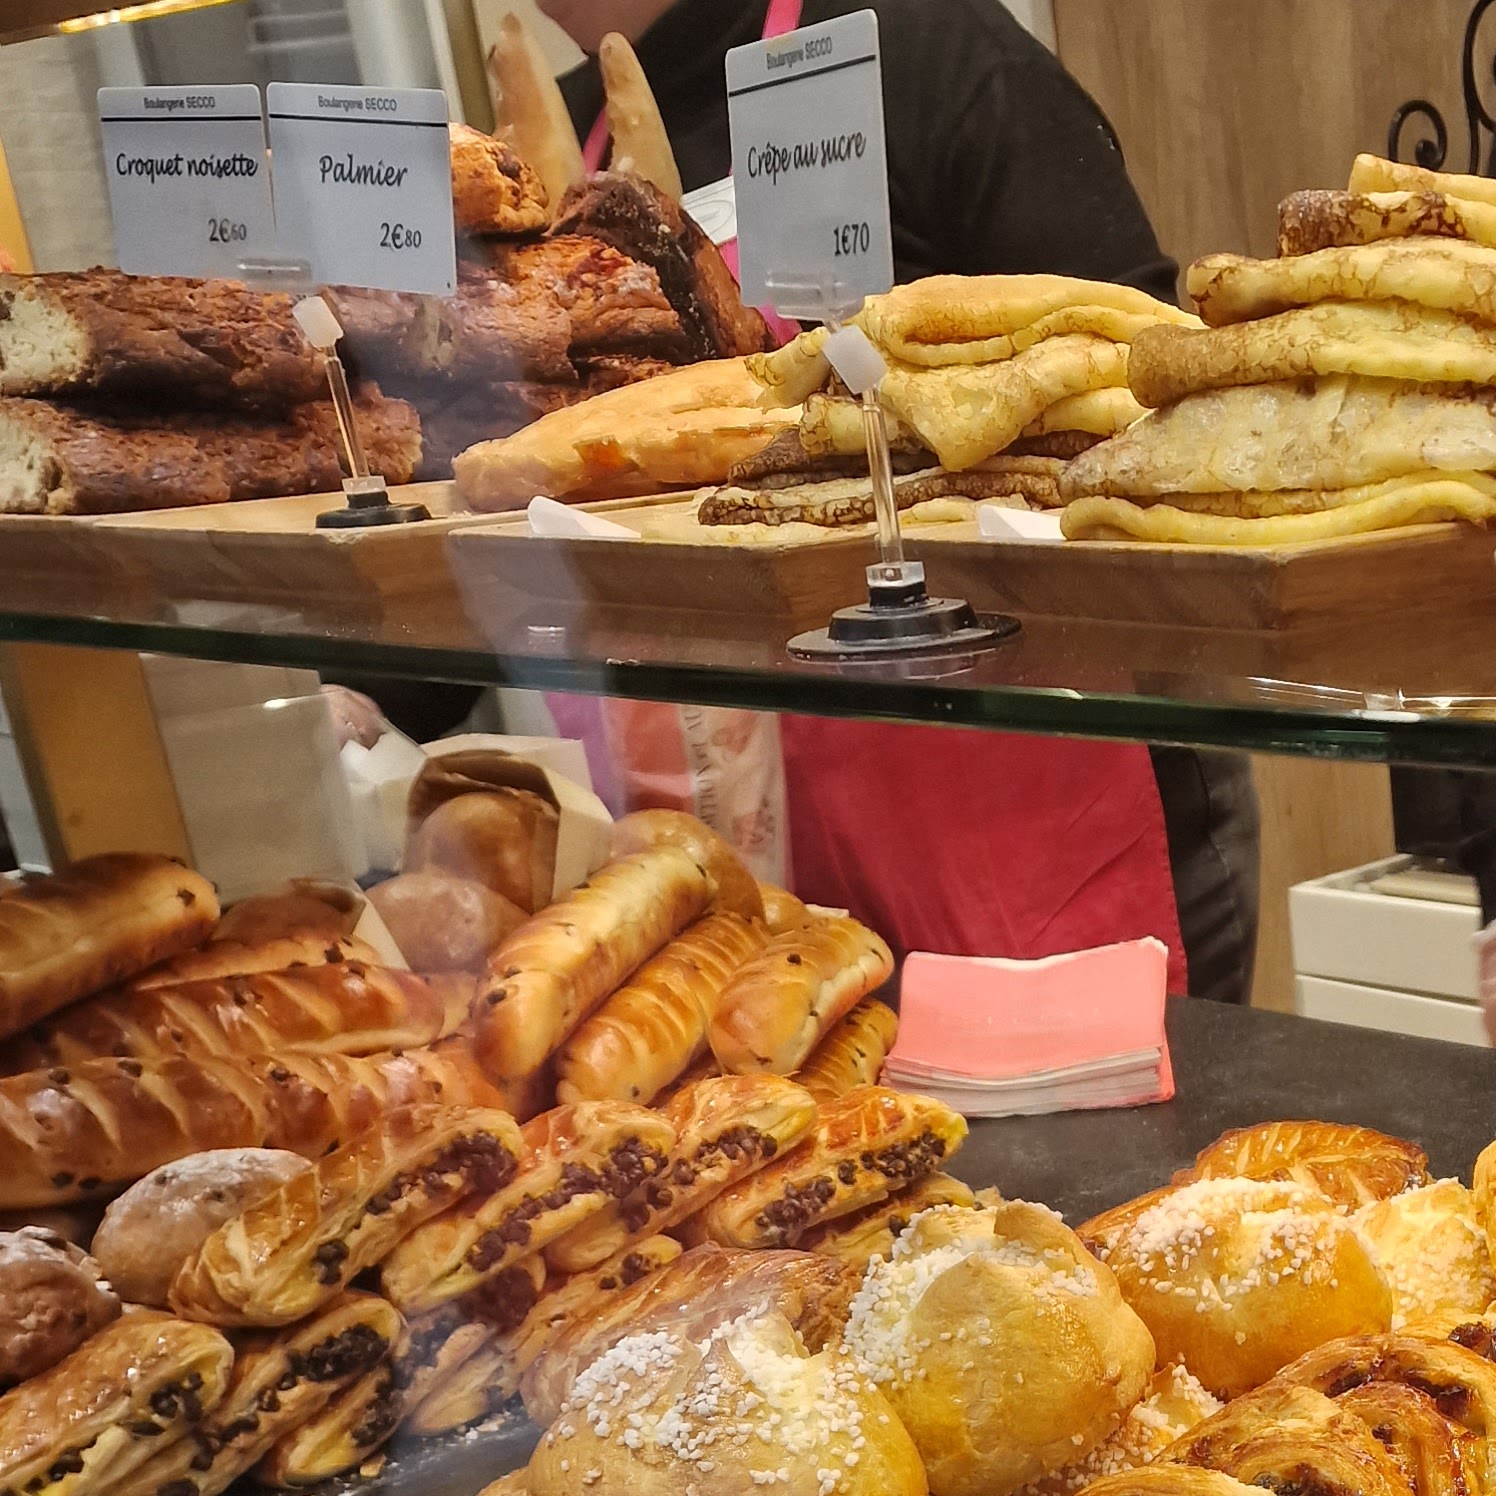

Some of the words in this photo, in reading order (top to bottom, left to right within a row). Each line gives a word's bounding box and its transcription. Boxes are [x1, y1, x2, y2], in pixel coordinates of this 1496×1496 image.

[805, 36, 833, 61] SECCO
[185, 96, 216, 109] SECCO
[365, 97, 398, 112] SECCO
[115, 152, 184, 184] Croquet
[187, 153, 259, 178] noisette
[319, 152, 408, 187] Palmier
[747, 141, 791, 186] Crêpe
[793, 142, 819, 170] au
[820, 131, 867, 168] sucre
[379, 222, 422, 249] 2€80
[833, 221, 870, 256] 1€70
